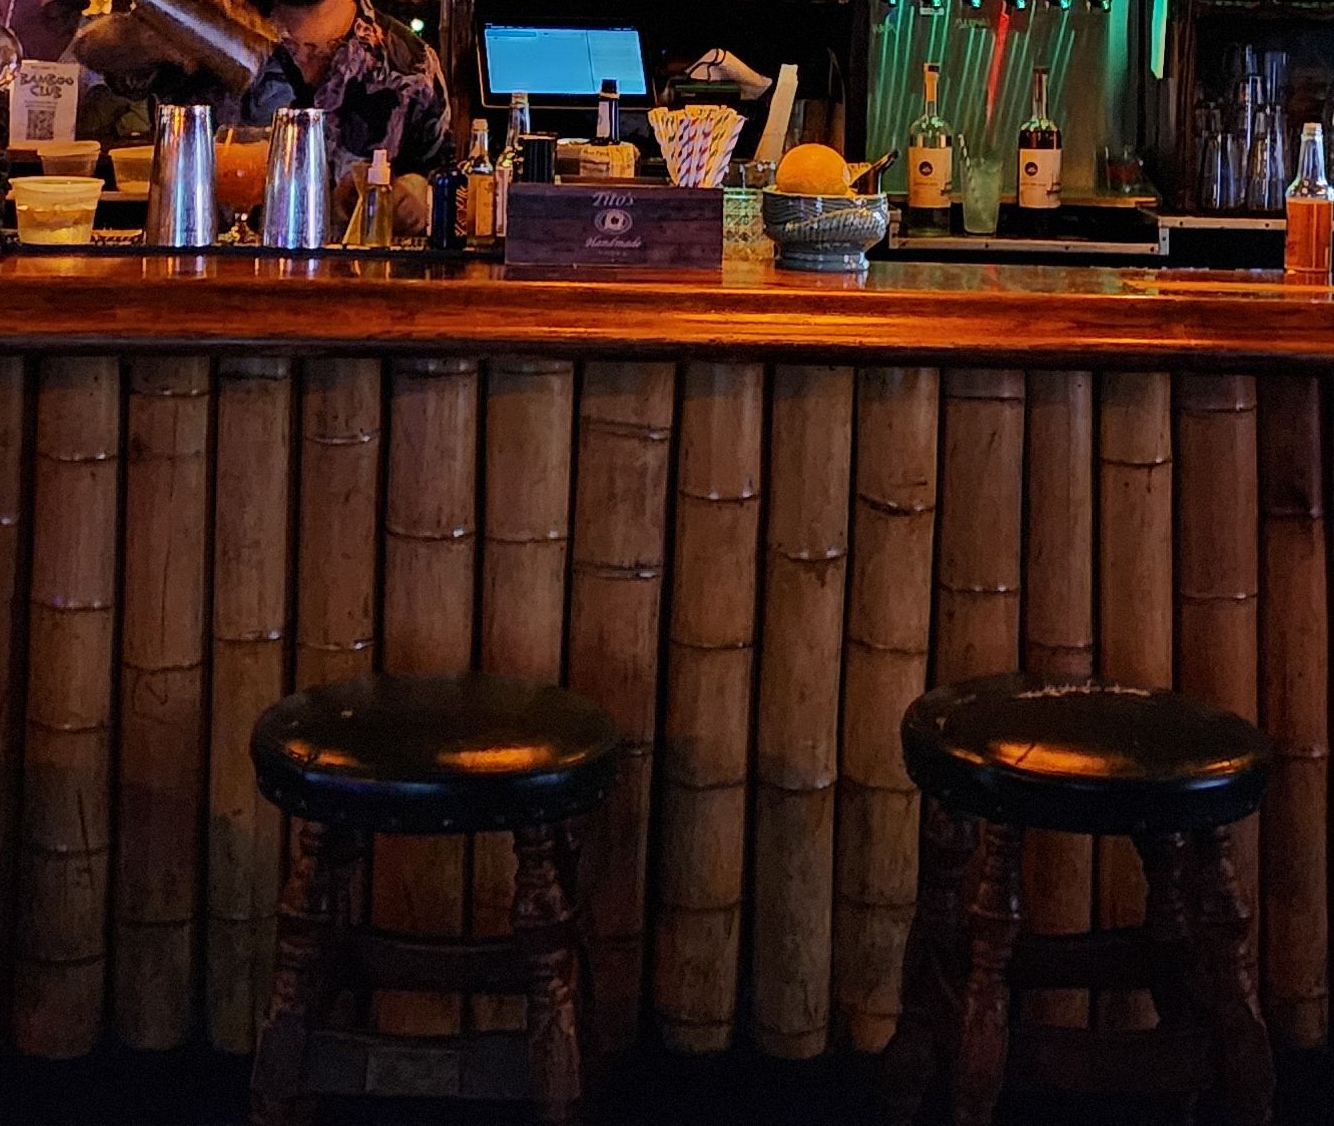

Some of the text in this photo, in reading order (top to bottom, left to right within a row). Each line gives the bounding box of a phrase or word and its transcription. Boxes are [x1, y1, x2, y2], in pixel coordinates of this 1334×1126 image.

[19, 73, 74, 86] BAMBOO
[30, 85, 62, 99] CLUB
[585, 235, 643, 249] Handmade
